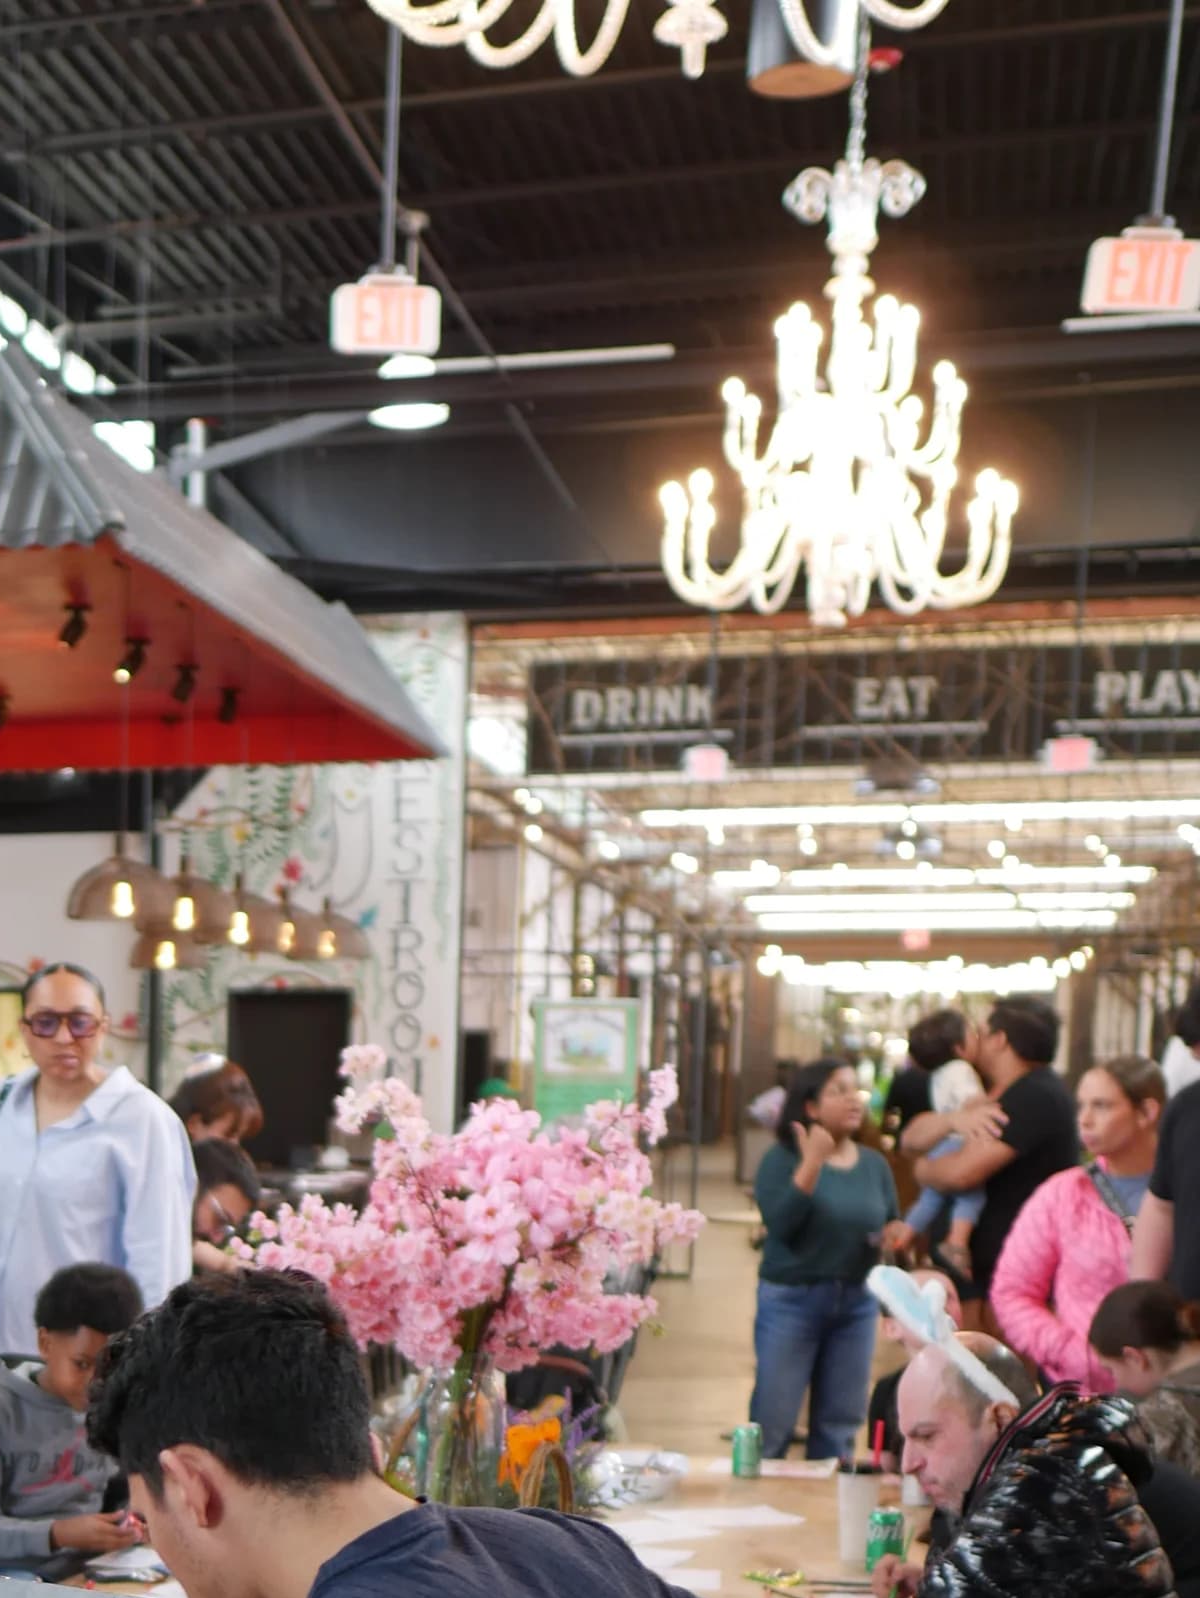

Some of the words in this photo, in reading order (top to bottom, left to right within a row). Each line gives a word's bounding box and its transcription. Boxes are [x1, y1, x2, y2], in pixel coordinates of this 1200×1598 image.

[1106, 241, 1194, 304] EXIT
[356, 287, 425, 345] EXIT
[572, 684, 713, 729] DRINK
[854, 676, 935, 719] EAT
[1094, 669, 1200, 714] PLAY
